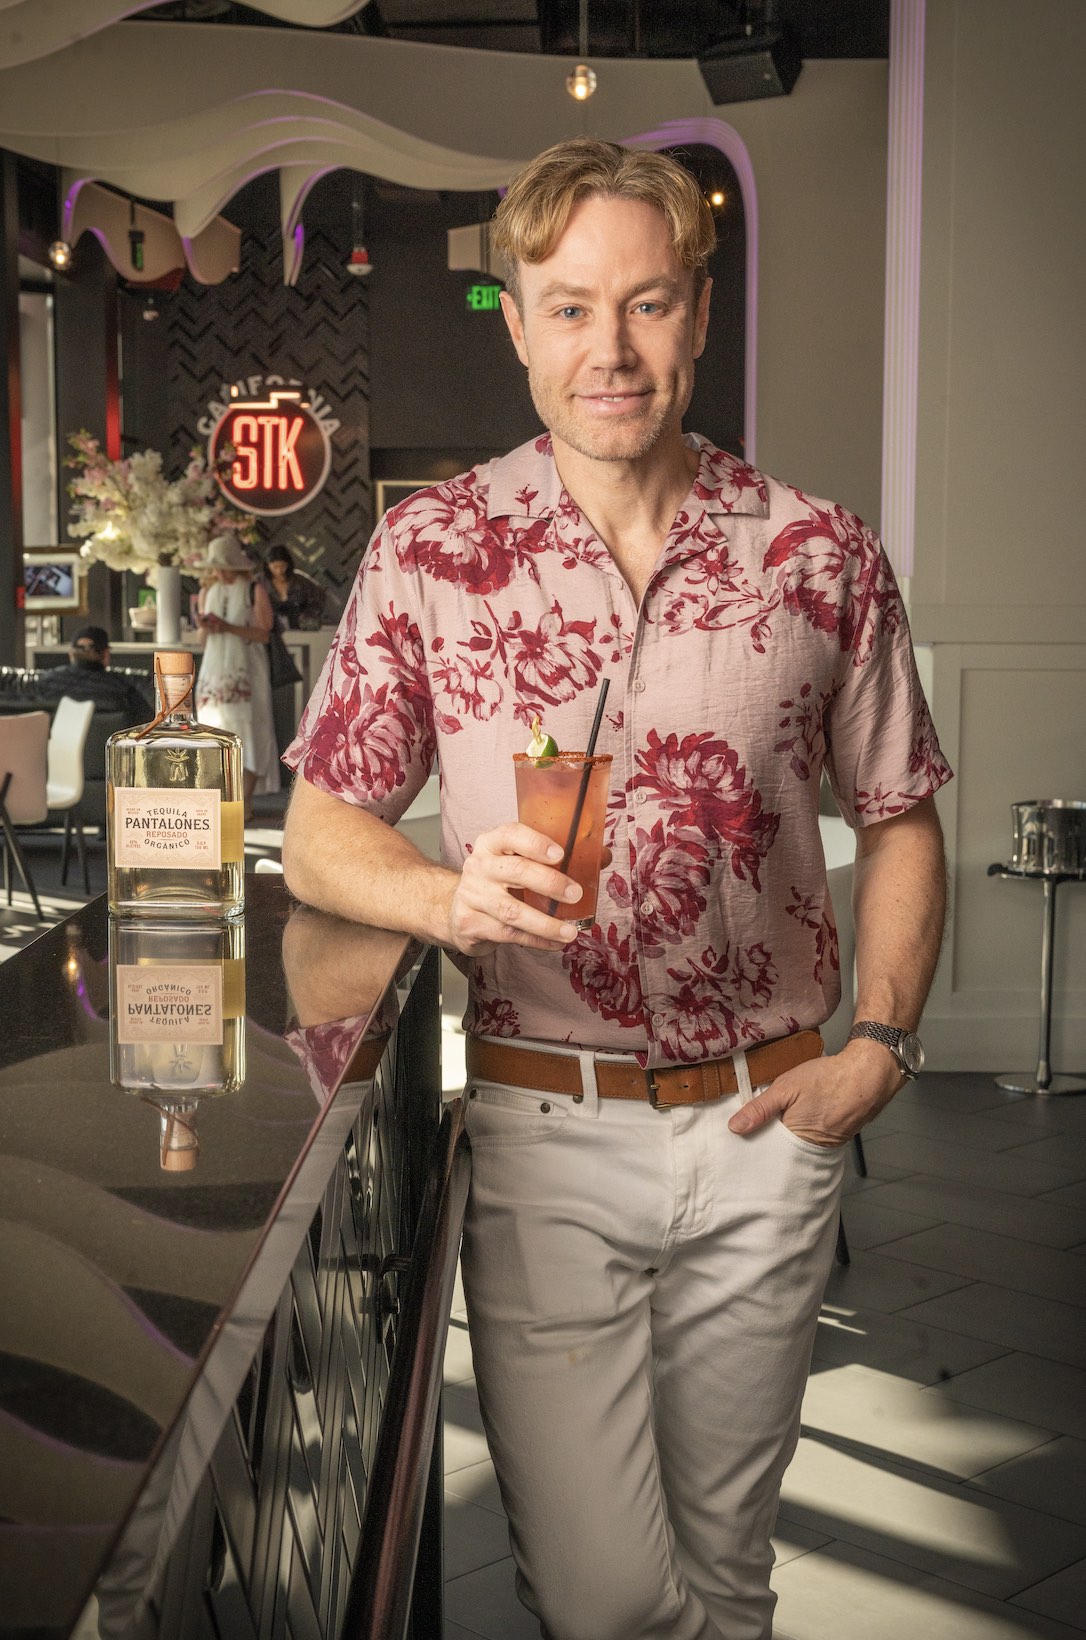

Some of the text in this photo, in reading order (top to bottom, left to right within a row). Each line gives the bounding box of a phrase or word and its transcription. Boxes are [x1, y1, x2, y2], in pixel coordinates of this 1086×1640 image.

[233, 415, 304, 490] STK
[147, 808, 188, 818] TEQUILA
[125, 817, 210, 830] PANTALONES
[146, 831, 188, 839] REPOSADO
